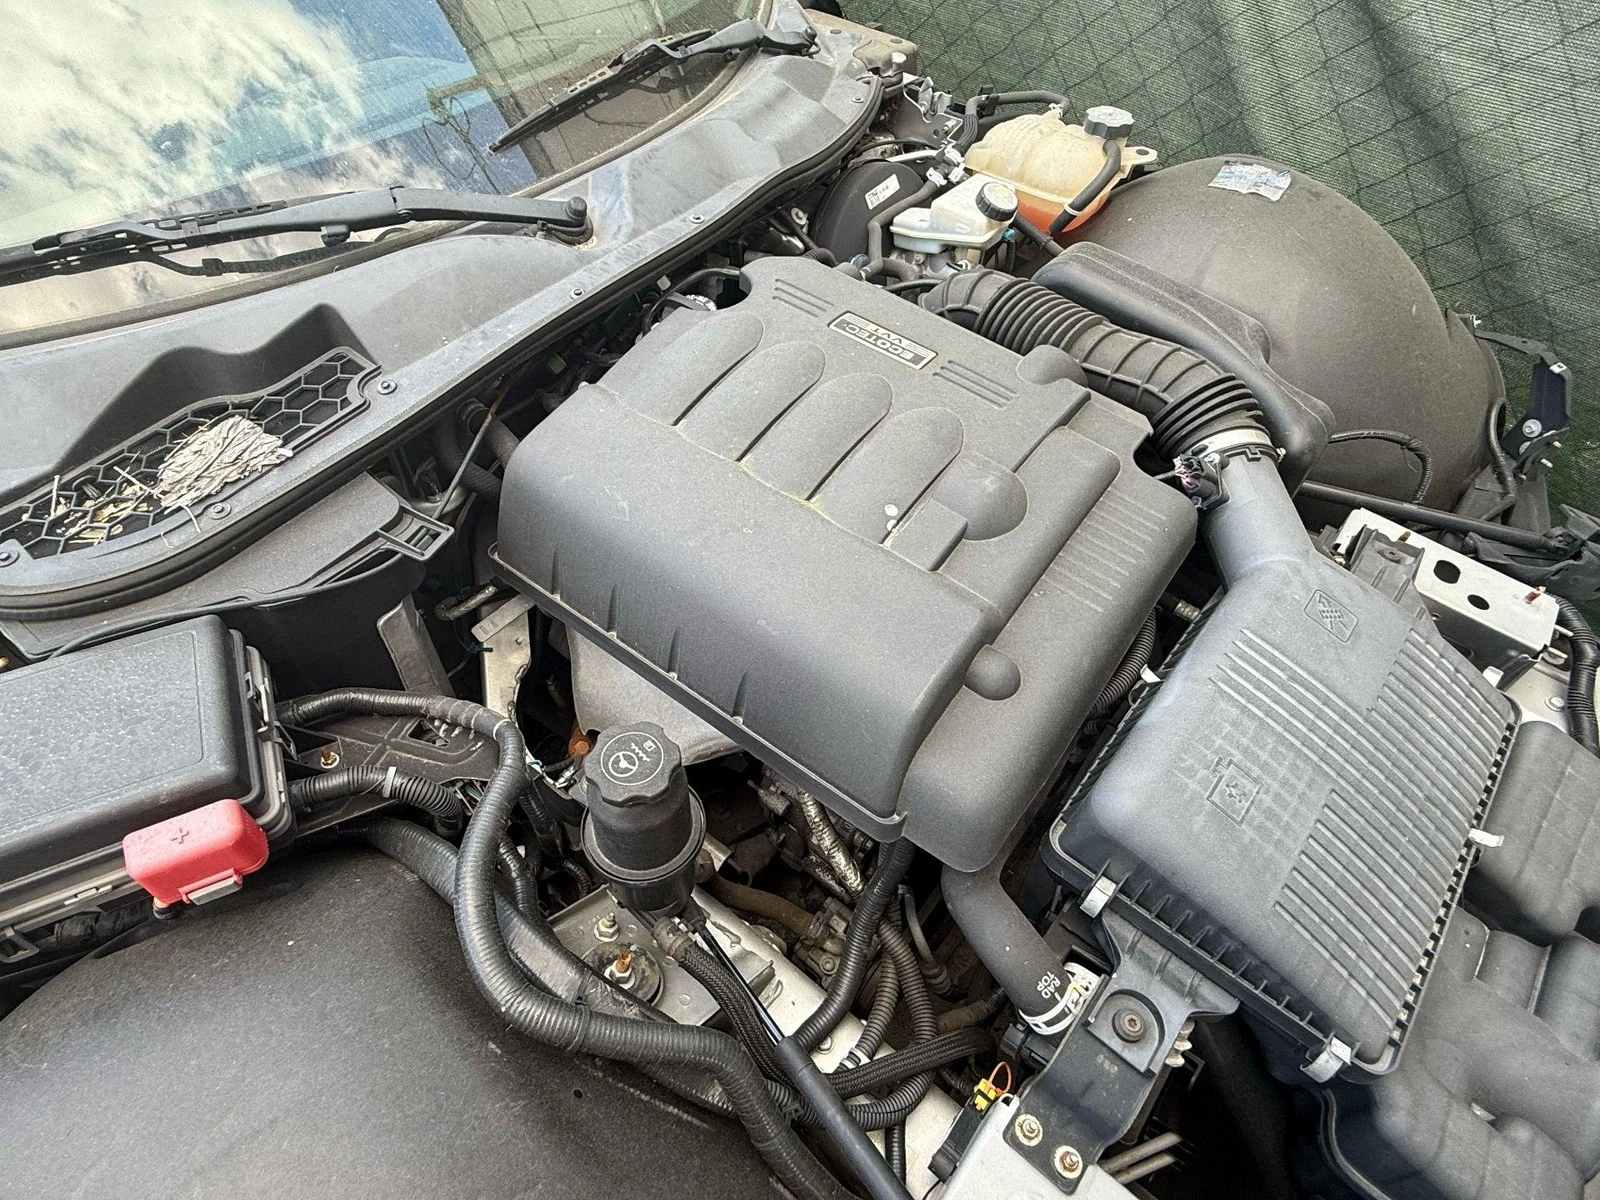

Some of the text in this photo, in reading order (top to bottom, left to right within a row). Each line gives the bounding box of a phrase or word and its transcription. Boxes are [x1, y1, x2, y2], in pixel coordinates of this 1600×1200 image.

[845, 324, 915, 360] ECOTEC
[872, 327, 903, 344] VVT
[1036, 971, 1055, 991] TOP
[1041, 976, 1061, 999] RAD
